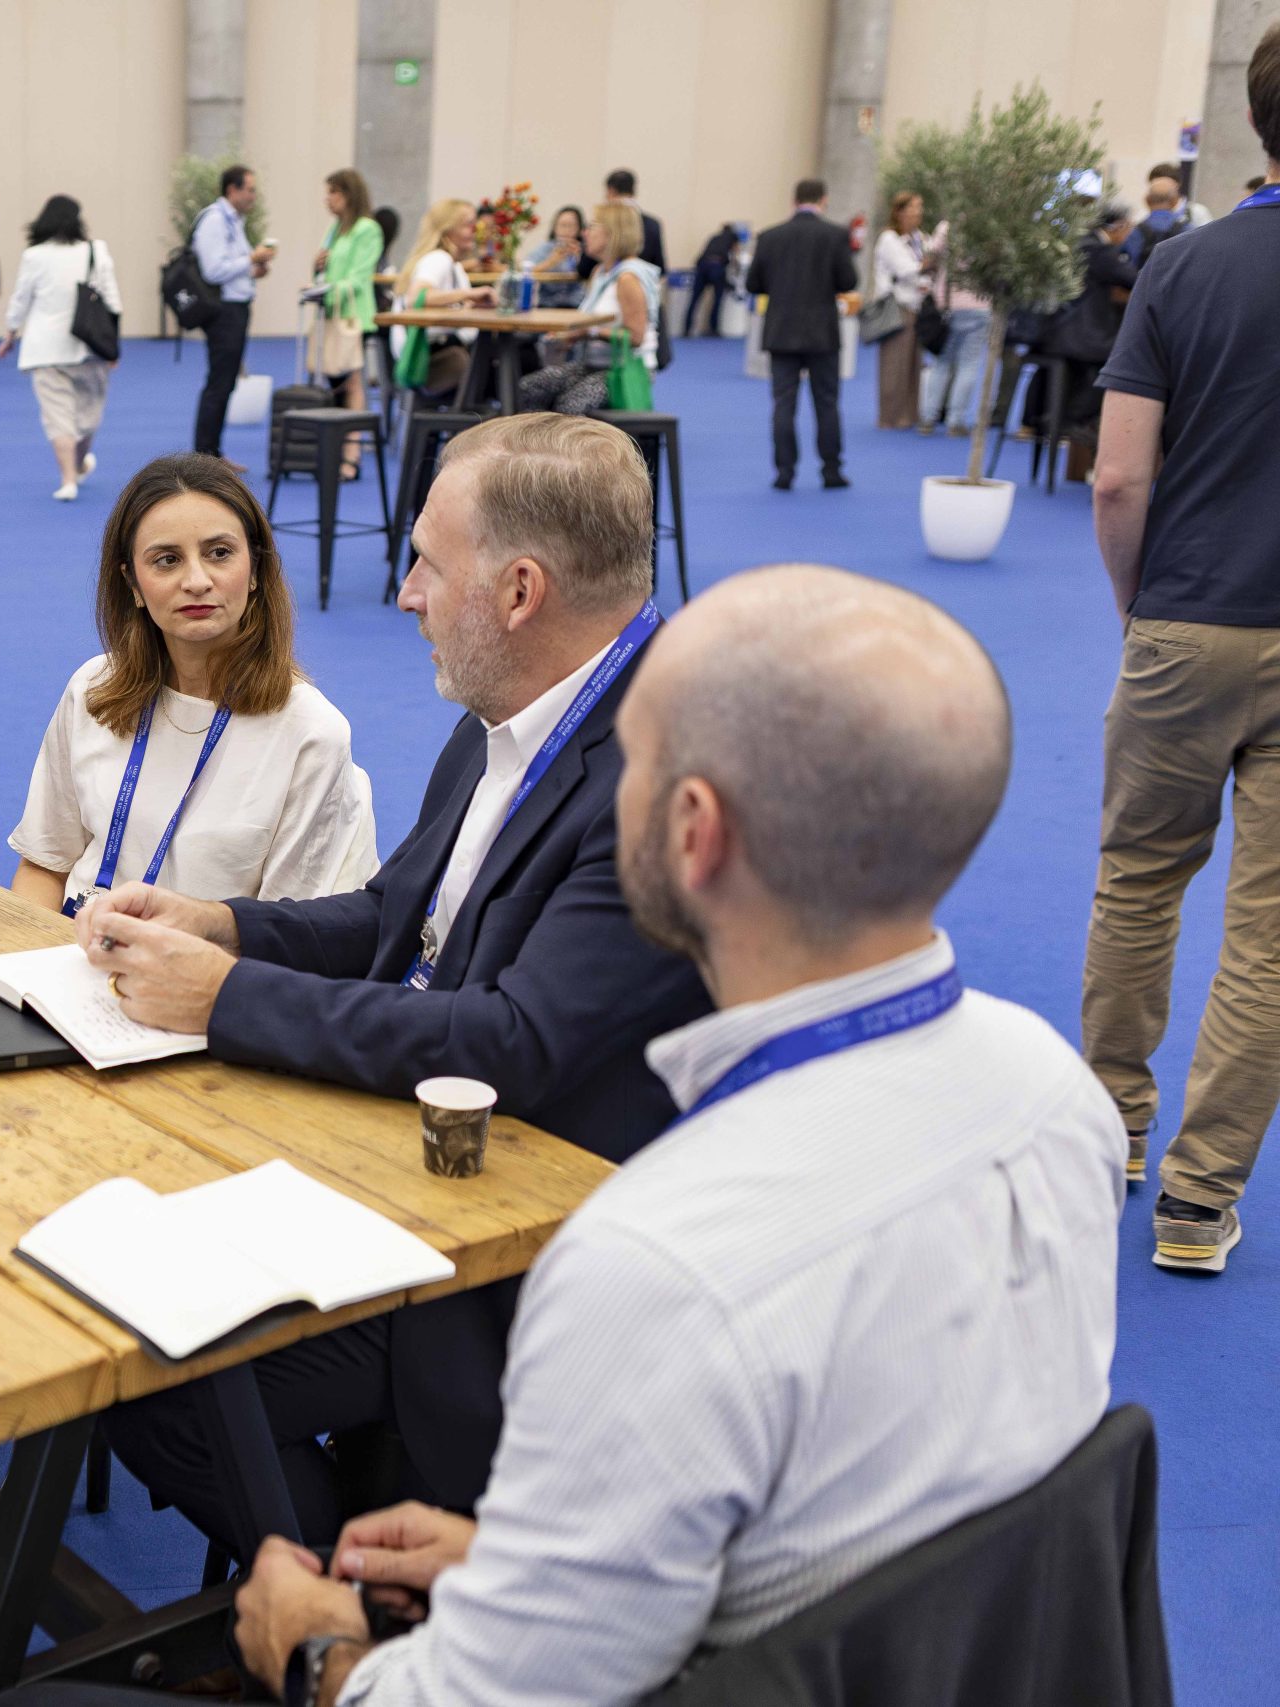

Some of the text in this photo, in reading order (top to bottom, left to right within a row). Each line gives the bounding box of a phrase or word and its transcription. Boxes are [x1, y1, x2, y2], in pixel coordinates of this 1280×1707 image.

[558, 647, 621, 732] INTERNATIONAL ASSOCIATION
[562, 642, 634, 736] FOR THE STUDY OF LUNG CANCER
[210, 732, 218, 745] FOR
[112, 782, 133, 854] INTERNATIONAL ASSOCIATION
[114, 801, 123, 819] STUDY
[112, 817, 119, 825] OF
[109, 825, 117, 840] LUNG
[104, 839, 114, 861] CANCER
